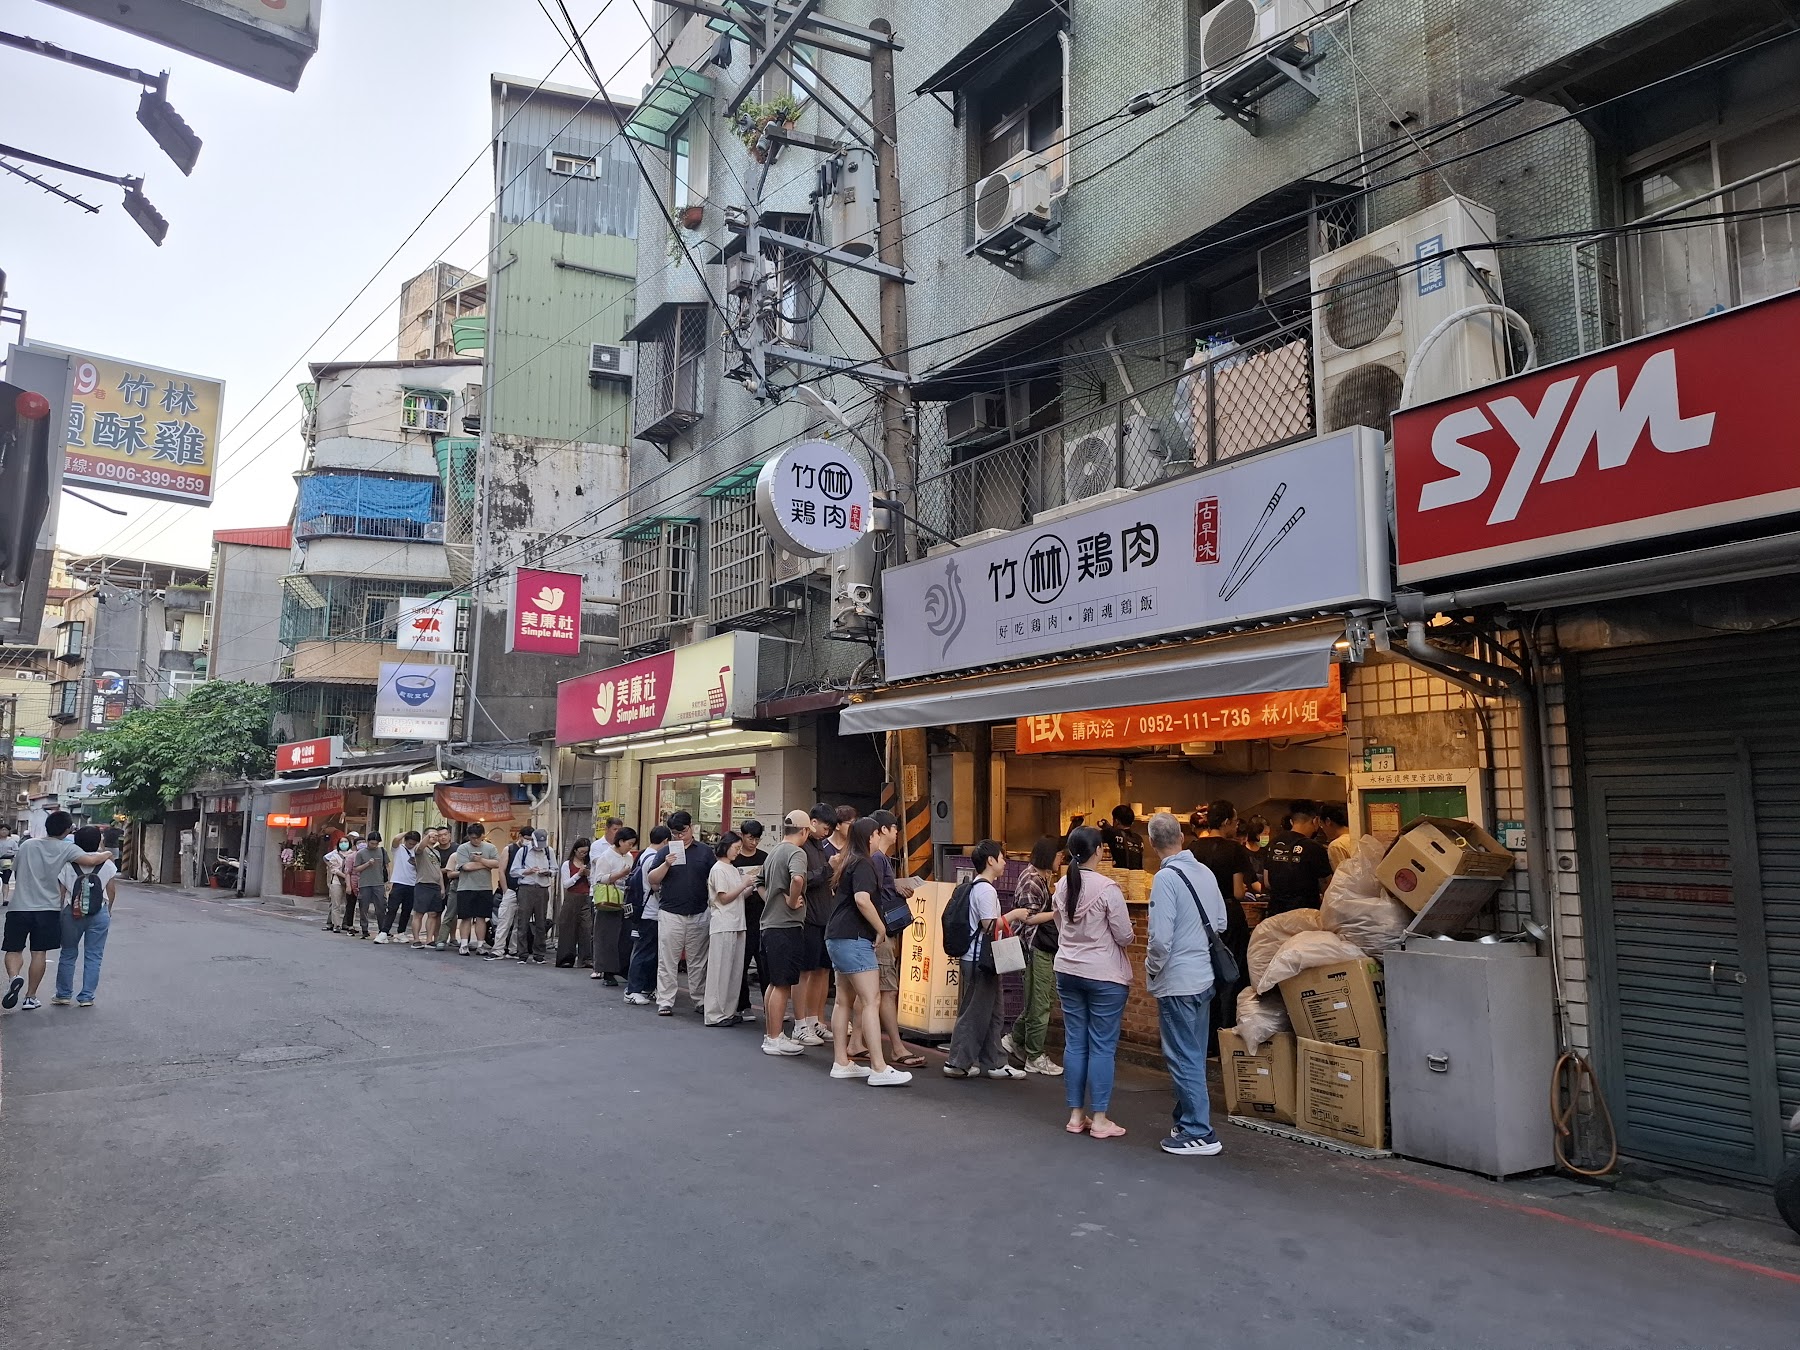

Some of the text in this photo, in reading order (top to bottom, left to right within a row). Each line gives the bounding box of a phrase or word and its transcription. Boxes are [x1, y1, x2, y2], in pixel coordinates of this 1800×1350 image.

[1421, 281, 1443, 293] MAPLE
[116, 371, 198, 416] 竹林
[1418, 348, 1716, 526] SYM
[96, 461, 205, 492] 0906-399-859
[791, 461, 852, 500] 竹林
[851, 505, 861, 530] 古早味
[1197, 500, 1217, 560] 古早味
[521, 611, 574, 631] 美廉社
[521, 627, 573, 639] Simple Mart
[617, 671, 657, 707] 美廉社
[616, 703, 655, 725] Simple Mart
[1139, 708, 1251, 734] 0952-111-736
[1261, 700, 1320, 726] 林小姐
[1378, 760, 1388, 769] 13
[1515, 837, 1527, 847] 15
